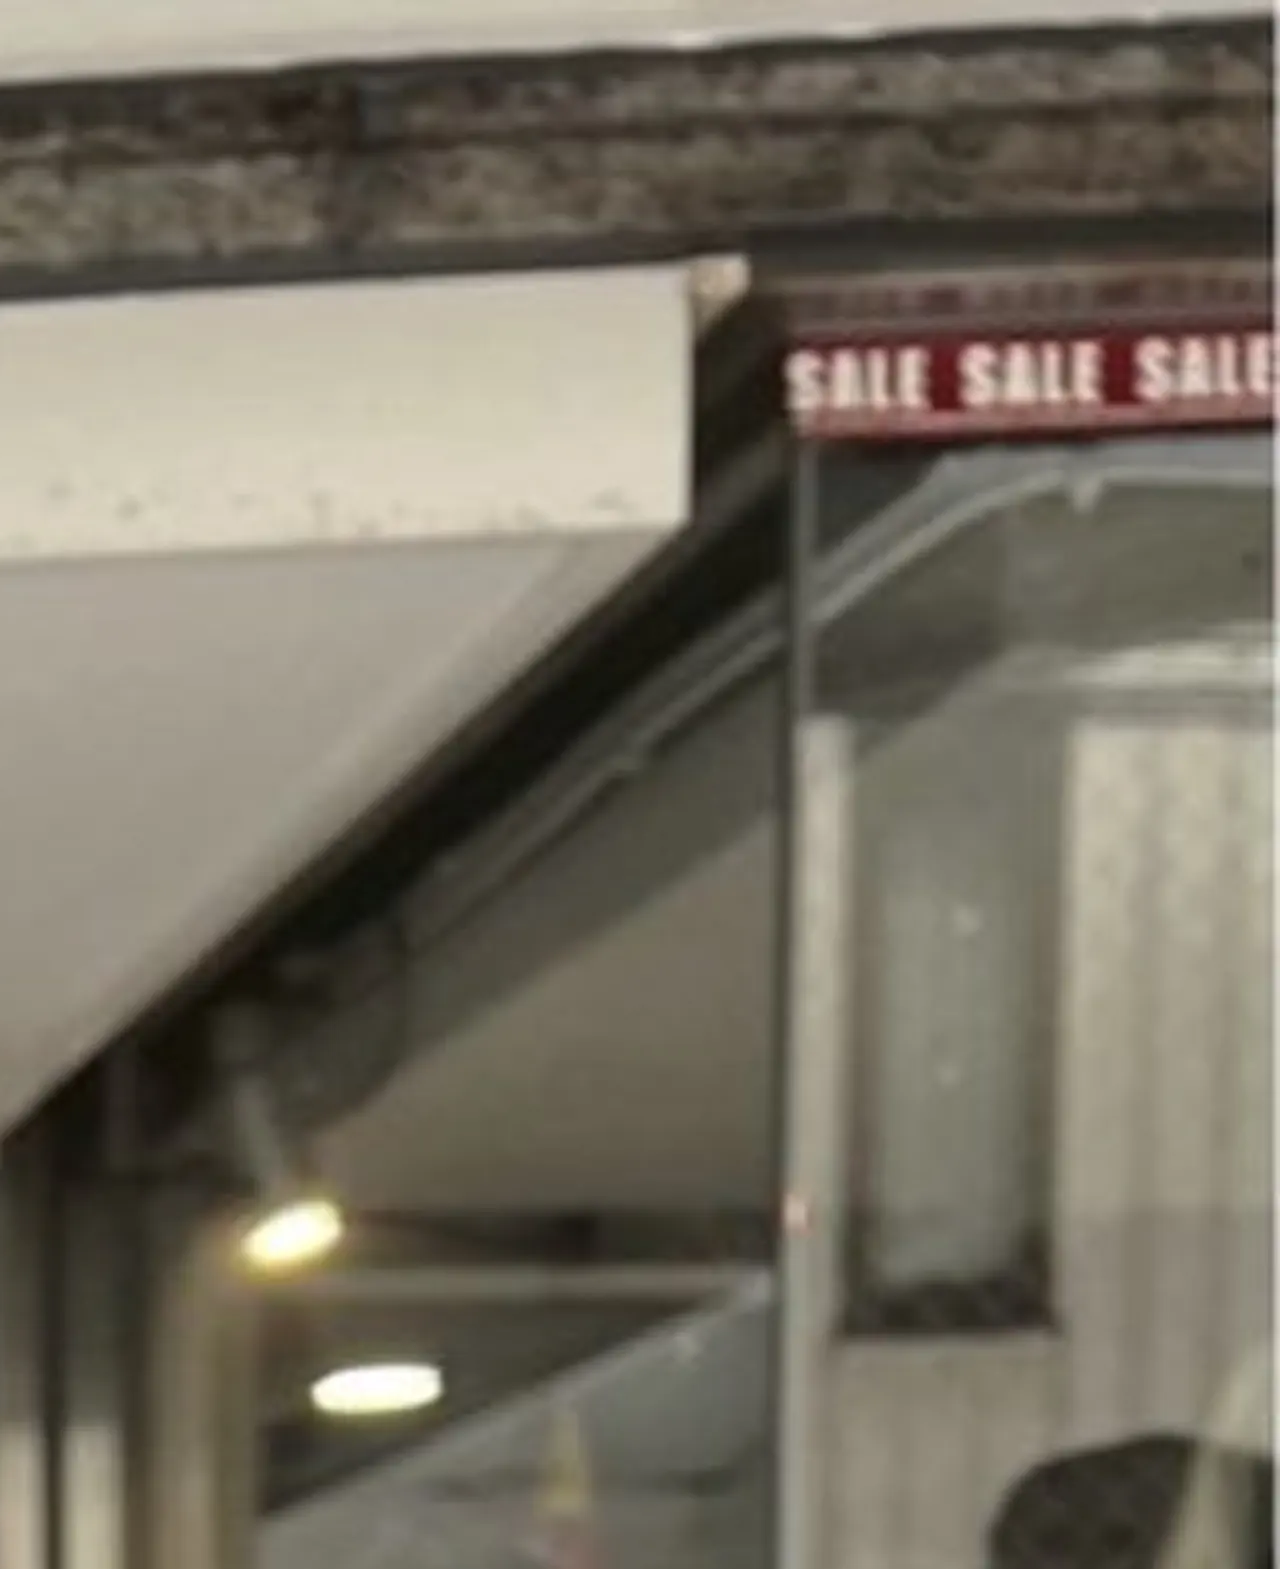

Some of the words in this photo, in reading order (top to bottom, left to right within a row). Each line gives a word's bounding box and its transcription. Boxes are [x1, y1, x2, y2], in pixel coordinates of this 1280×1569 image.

[785, 346, 930, 411] SALE
[959, 339, 1103, 406] SALE
[1134, 333, 1275, 402] SALE
